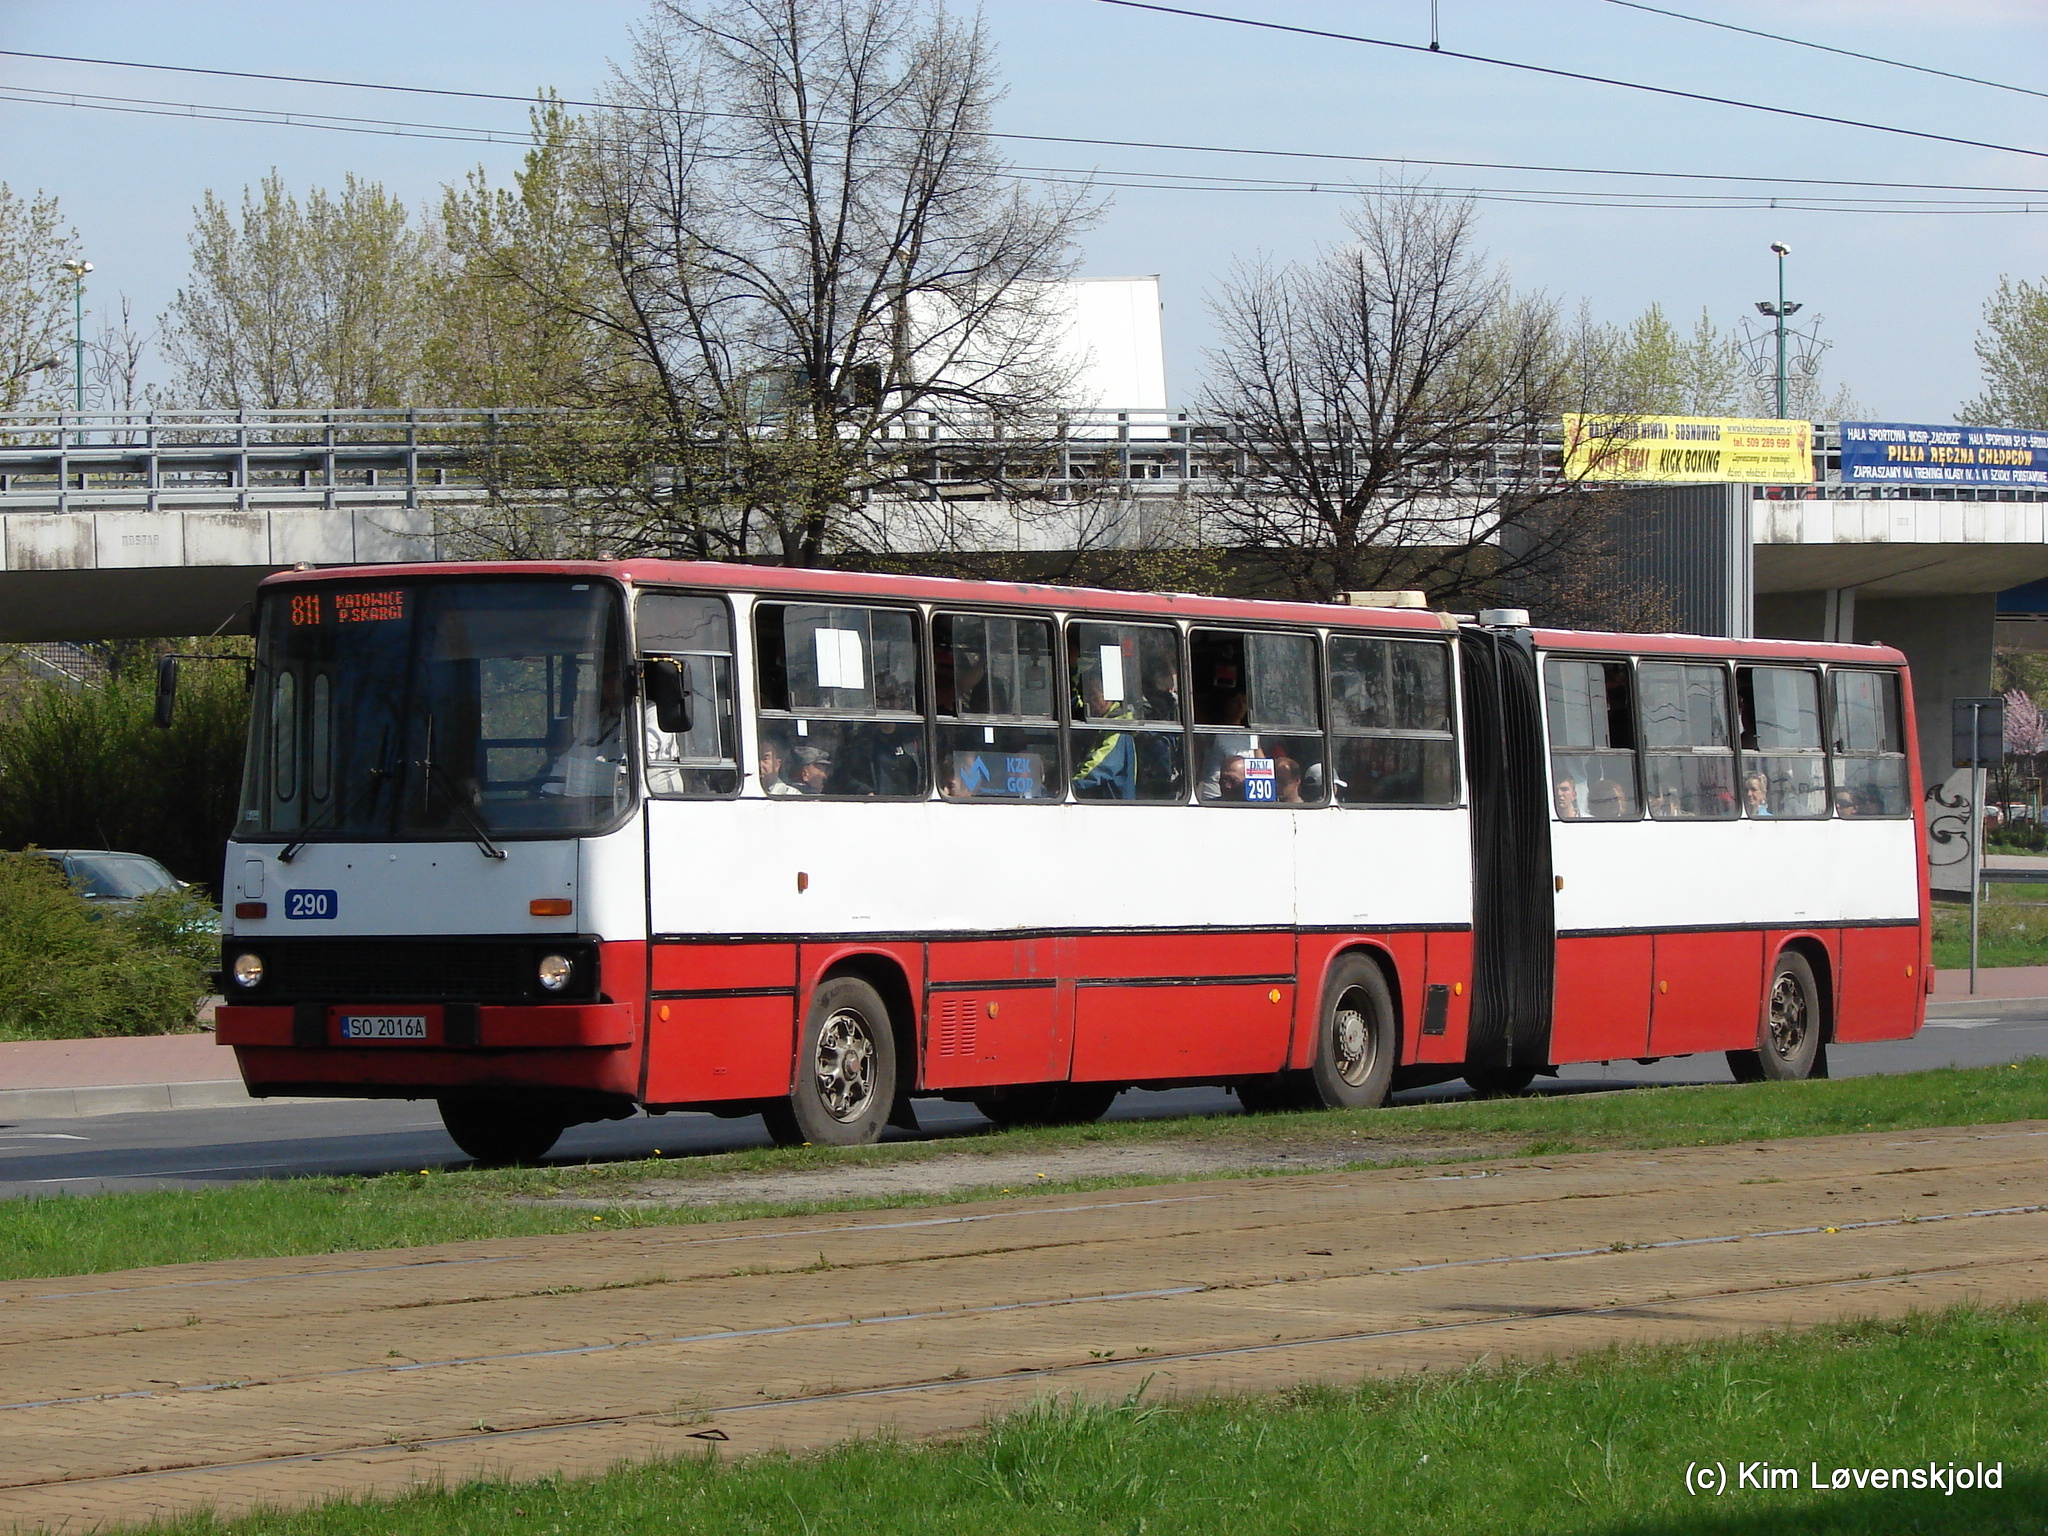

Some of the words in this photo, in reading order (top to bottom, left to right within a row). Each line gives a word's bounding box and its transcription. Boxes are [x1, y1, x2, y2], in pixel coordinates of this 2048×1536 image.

[1675, 423, 1721, 441] SOSNOWIEC
[1847, 427, 1867, 441] HALA
[1868, 428, 1907, 442] SPORTOWA
[1968, 432, 1984, 446] HALA
[1985, 432, 2012, 447] SPORTOWA
[1733, 437, 1744, 447] tel.
[1746, 437, 1759, 447] 509
[1761, 438, 1774, 448] 289
[1776, 438, 1790, 448] 699
[1659, 448, 1683, 474] KICK
[1684, 448, 1721, 473] BOXING
[1887, 445, 1925, 462] PIŁKA
[1930, 446, 1975, 467] RĘCZNA
[1978, 447, 2033, 466] CHŁOPCÓW
[1853, 465, 1901, 479] ZAPRASZAMY
[1902, 465, 1913, 479] NA
[1944, 467, 1964, 480] KLASY
[335, 591, 404, 609] KATOWICE
[291, 594, 320, 626] 811
[338, 605, 403, 623] P.SKARGI
[1006, 757, 1031, 774] KZK
[1248, 779, 1272, 800] 290
[292, 893, 328, 916] 290
[350, 1018, 373, 1036] SO
[377, 1018, 424, 1036] 2016A
